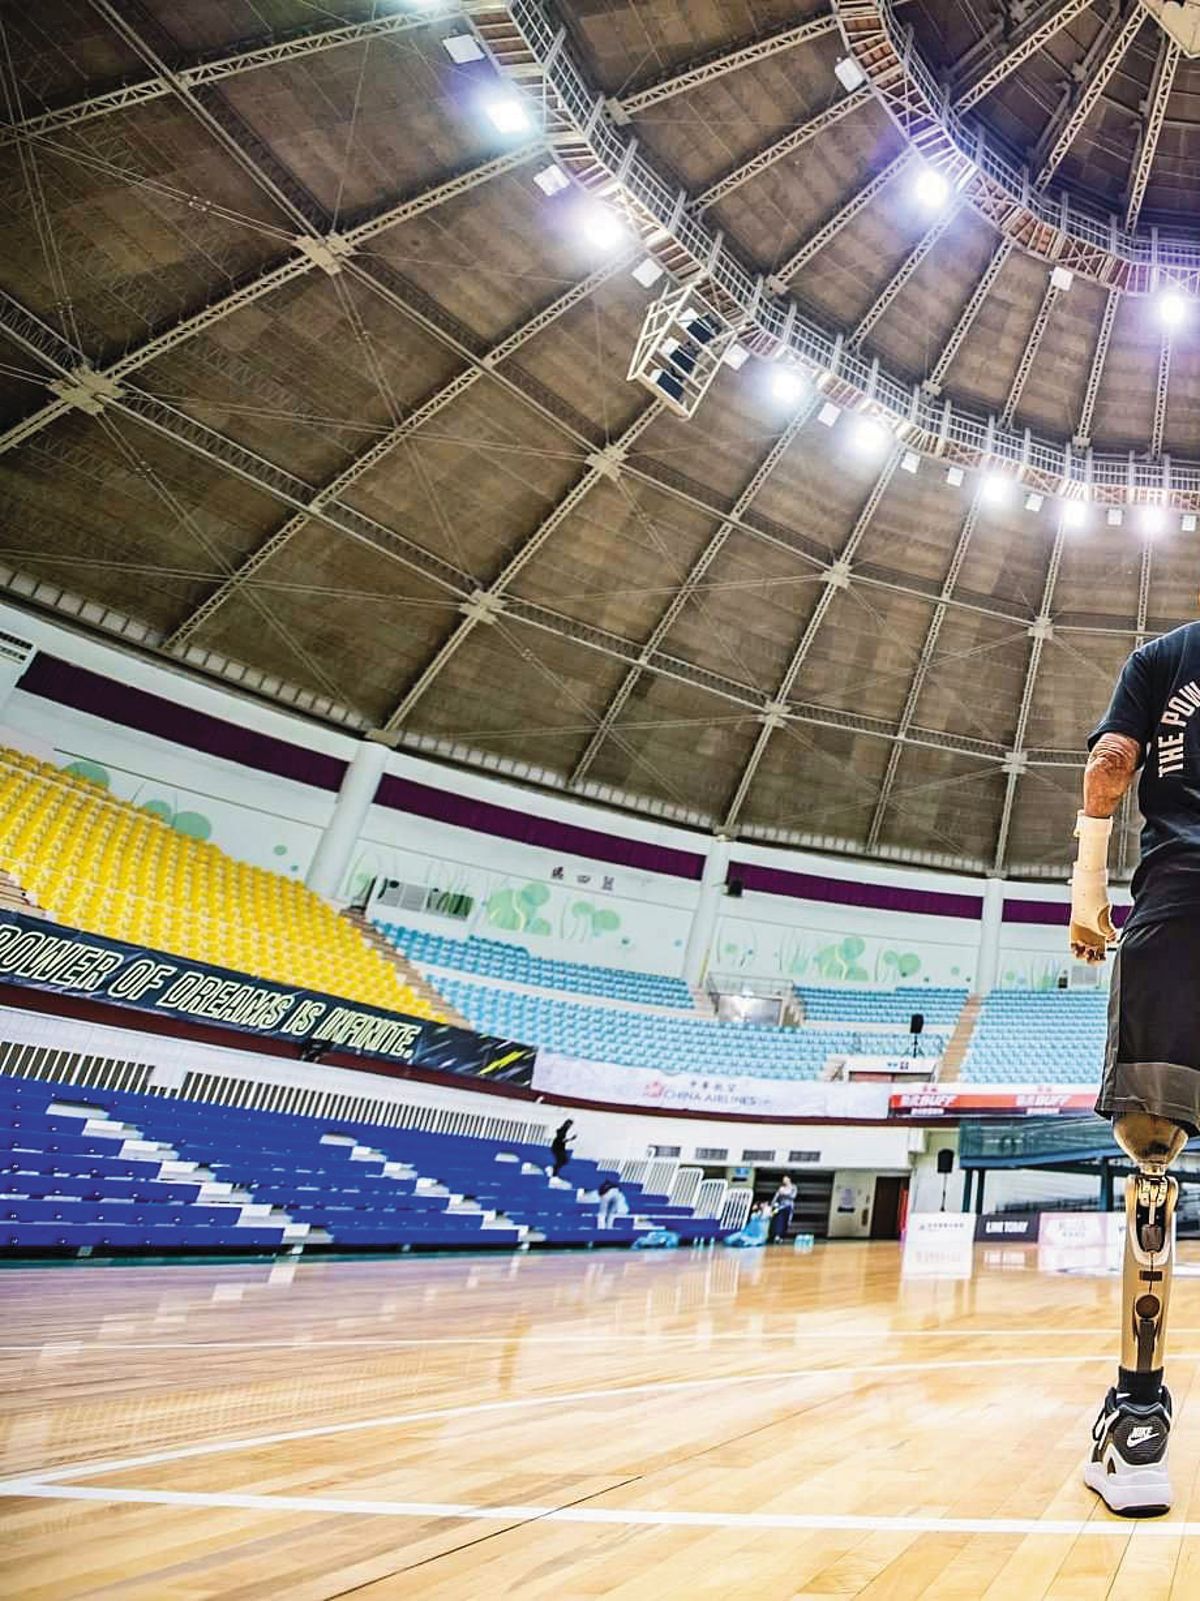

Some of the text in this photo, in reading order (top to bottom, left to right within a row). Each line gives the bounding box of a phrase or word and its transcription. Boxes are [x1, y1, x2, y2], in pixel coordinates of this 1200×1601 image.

[1158, 732, 1184, 778] THE
[108, 960, 172, 998] OF
[159, 971, 297, 1028] DREAMS
[283, 999, 325, 1036] IS
[1131, 1426, 1153, 1439] NIKE
